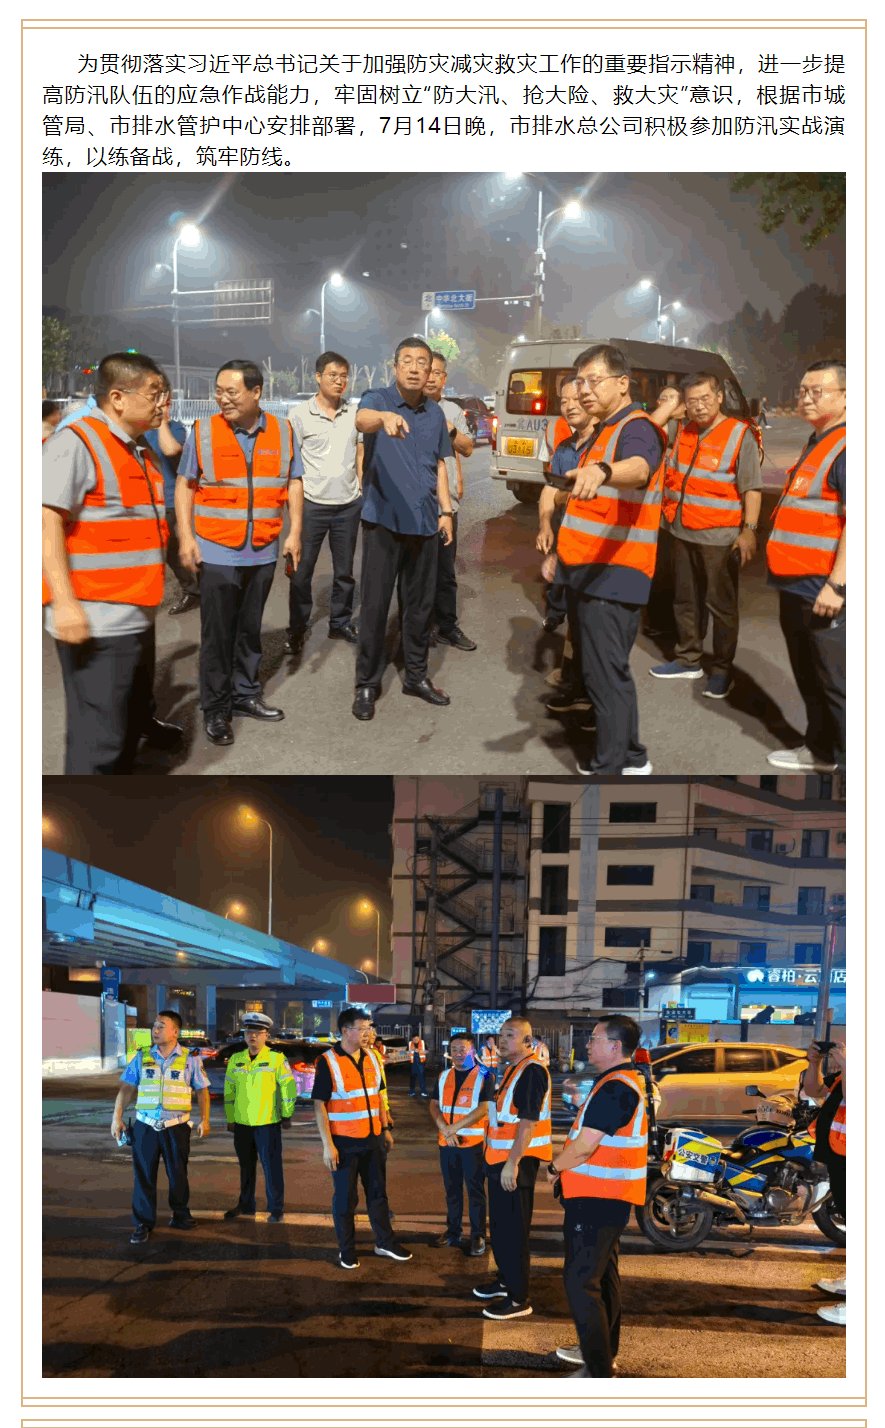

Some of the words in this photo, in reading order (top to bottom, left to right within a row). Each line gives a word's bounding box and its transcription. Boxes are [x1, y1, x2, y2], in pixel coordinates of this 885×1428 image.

[768, 968, 846, 983] 睿柏·云店
[678, 1149, 708, 1165] 公安交警
